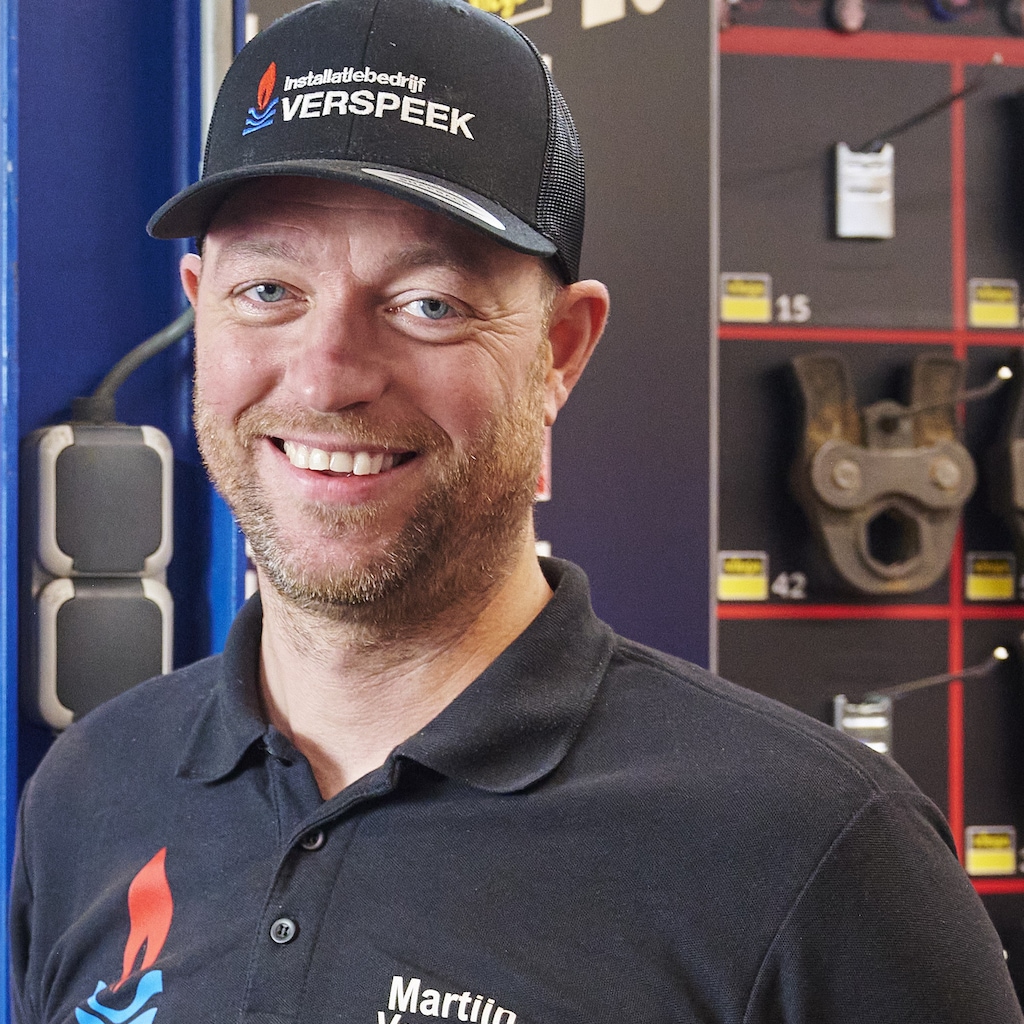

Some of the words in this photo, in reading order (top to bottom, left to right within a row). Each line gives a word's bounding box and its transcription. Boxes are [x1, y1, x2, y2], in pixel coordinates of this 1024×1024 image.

[284, 66, 427, 93] Installatiebedrijf
[280, 89, 476, 140] VERSPEEK
[776, 294, 811, 322] 15
[771, 571, 808, 599] 42
